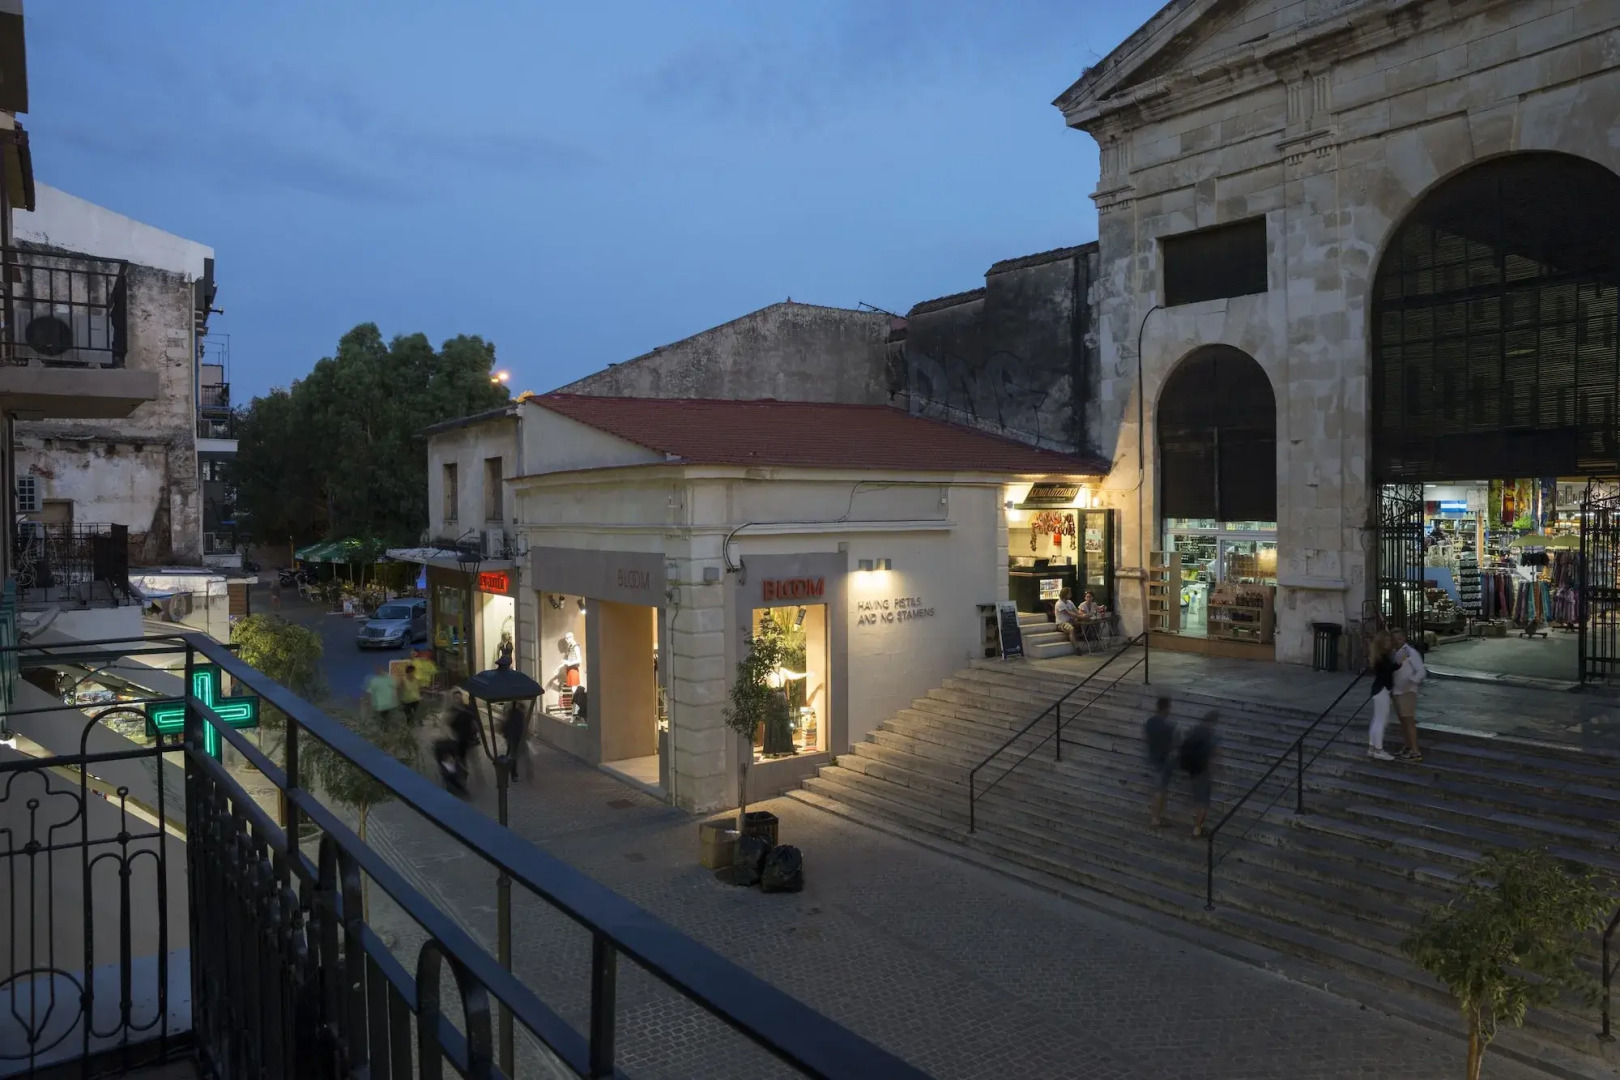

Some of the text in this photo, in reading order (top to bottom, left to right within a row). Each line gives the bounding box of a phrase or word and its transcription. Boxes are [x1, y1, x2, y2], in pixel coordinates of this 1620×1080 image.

[617, 568, 650, 589] BLOOM
[762, 576, 825, 602] BLOOM
[857, 599, 889, 611] HAVING
[857, 607, 935, 625] AND NO STAMENS
